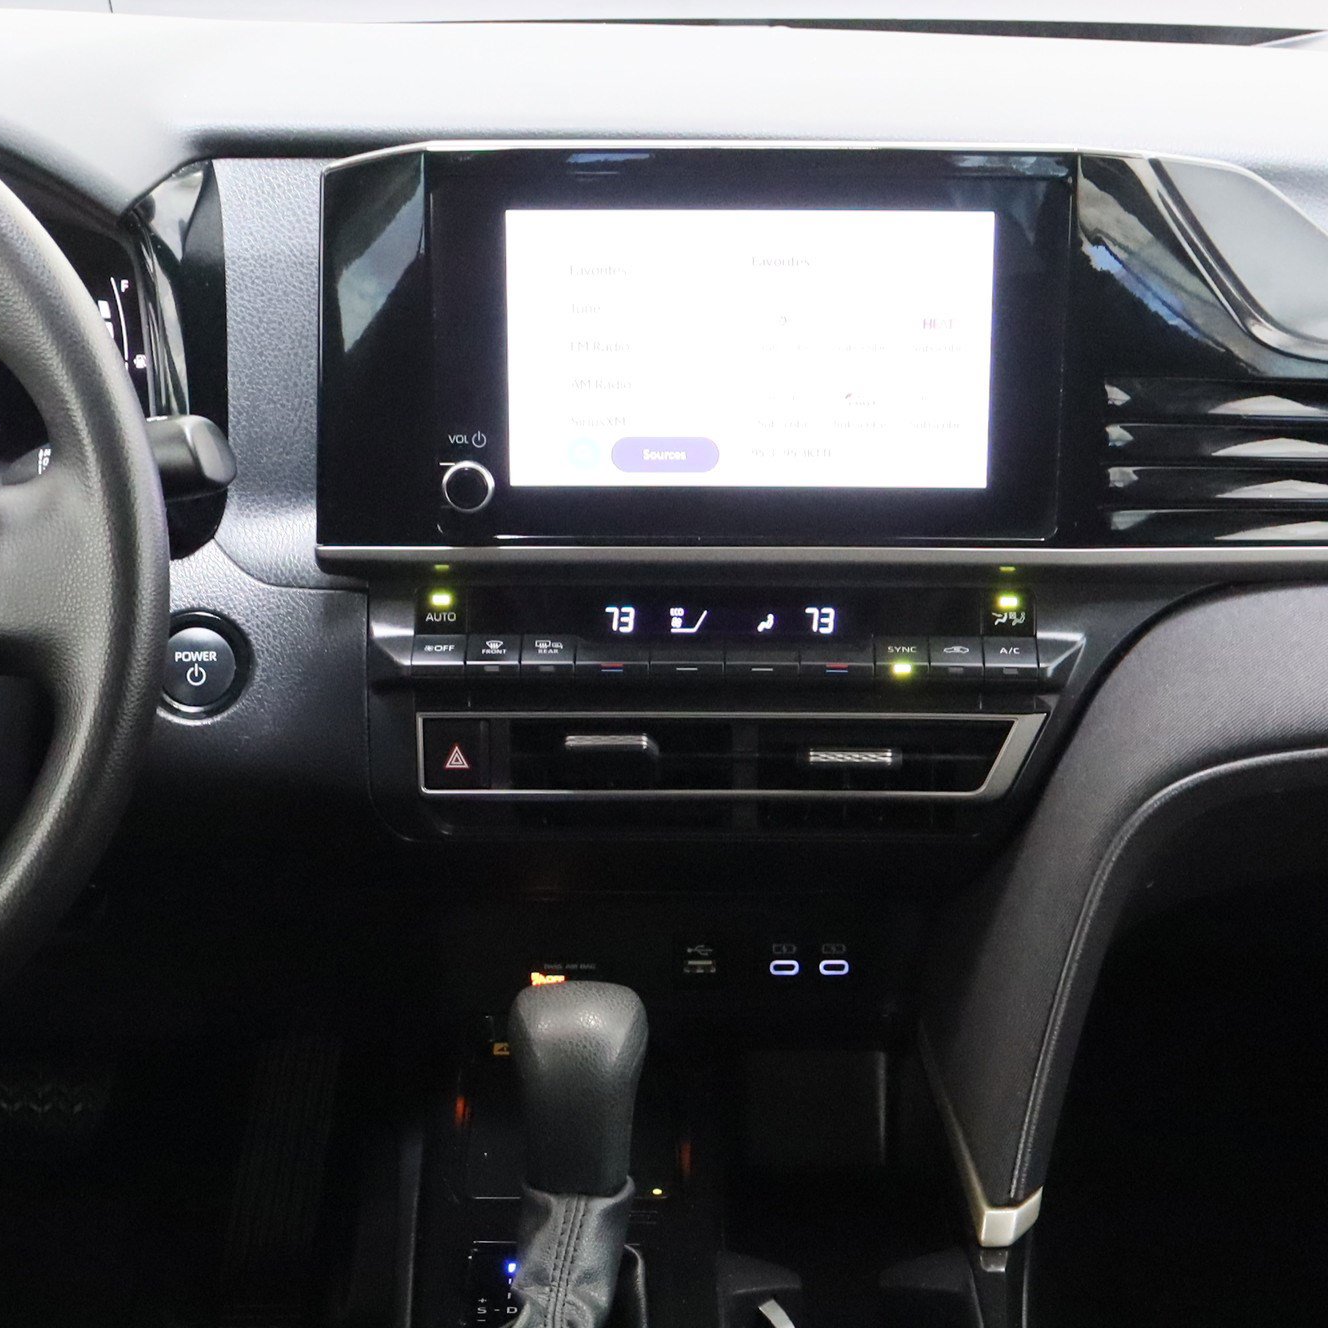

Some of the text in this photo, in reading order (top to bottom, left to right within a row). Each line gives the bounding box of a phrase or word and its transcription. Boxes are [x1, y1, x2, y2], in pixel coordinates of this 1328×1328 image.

[121, 280, 129, 292] F
[448, 434, 469, 444] VOL
[642, 448, 687, 461] Sources
[425, 612, 457, 622] AUTO
[605, 606, 635, 633] 73
[805, 607, 835, 634] 73
[434, 644, 455, 652] OFF
[999, 647, 1020, 655] A/C
[174, 651, 217, 662] POWER
[477, 1306, 518, 1314] S D
